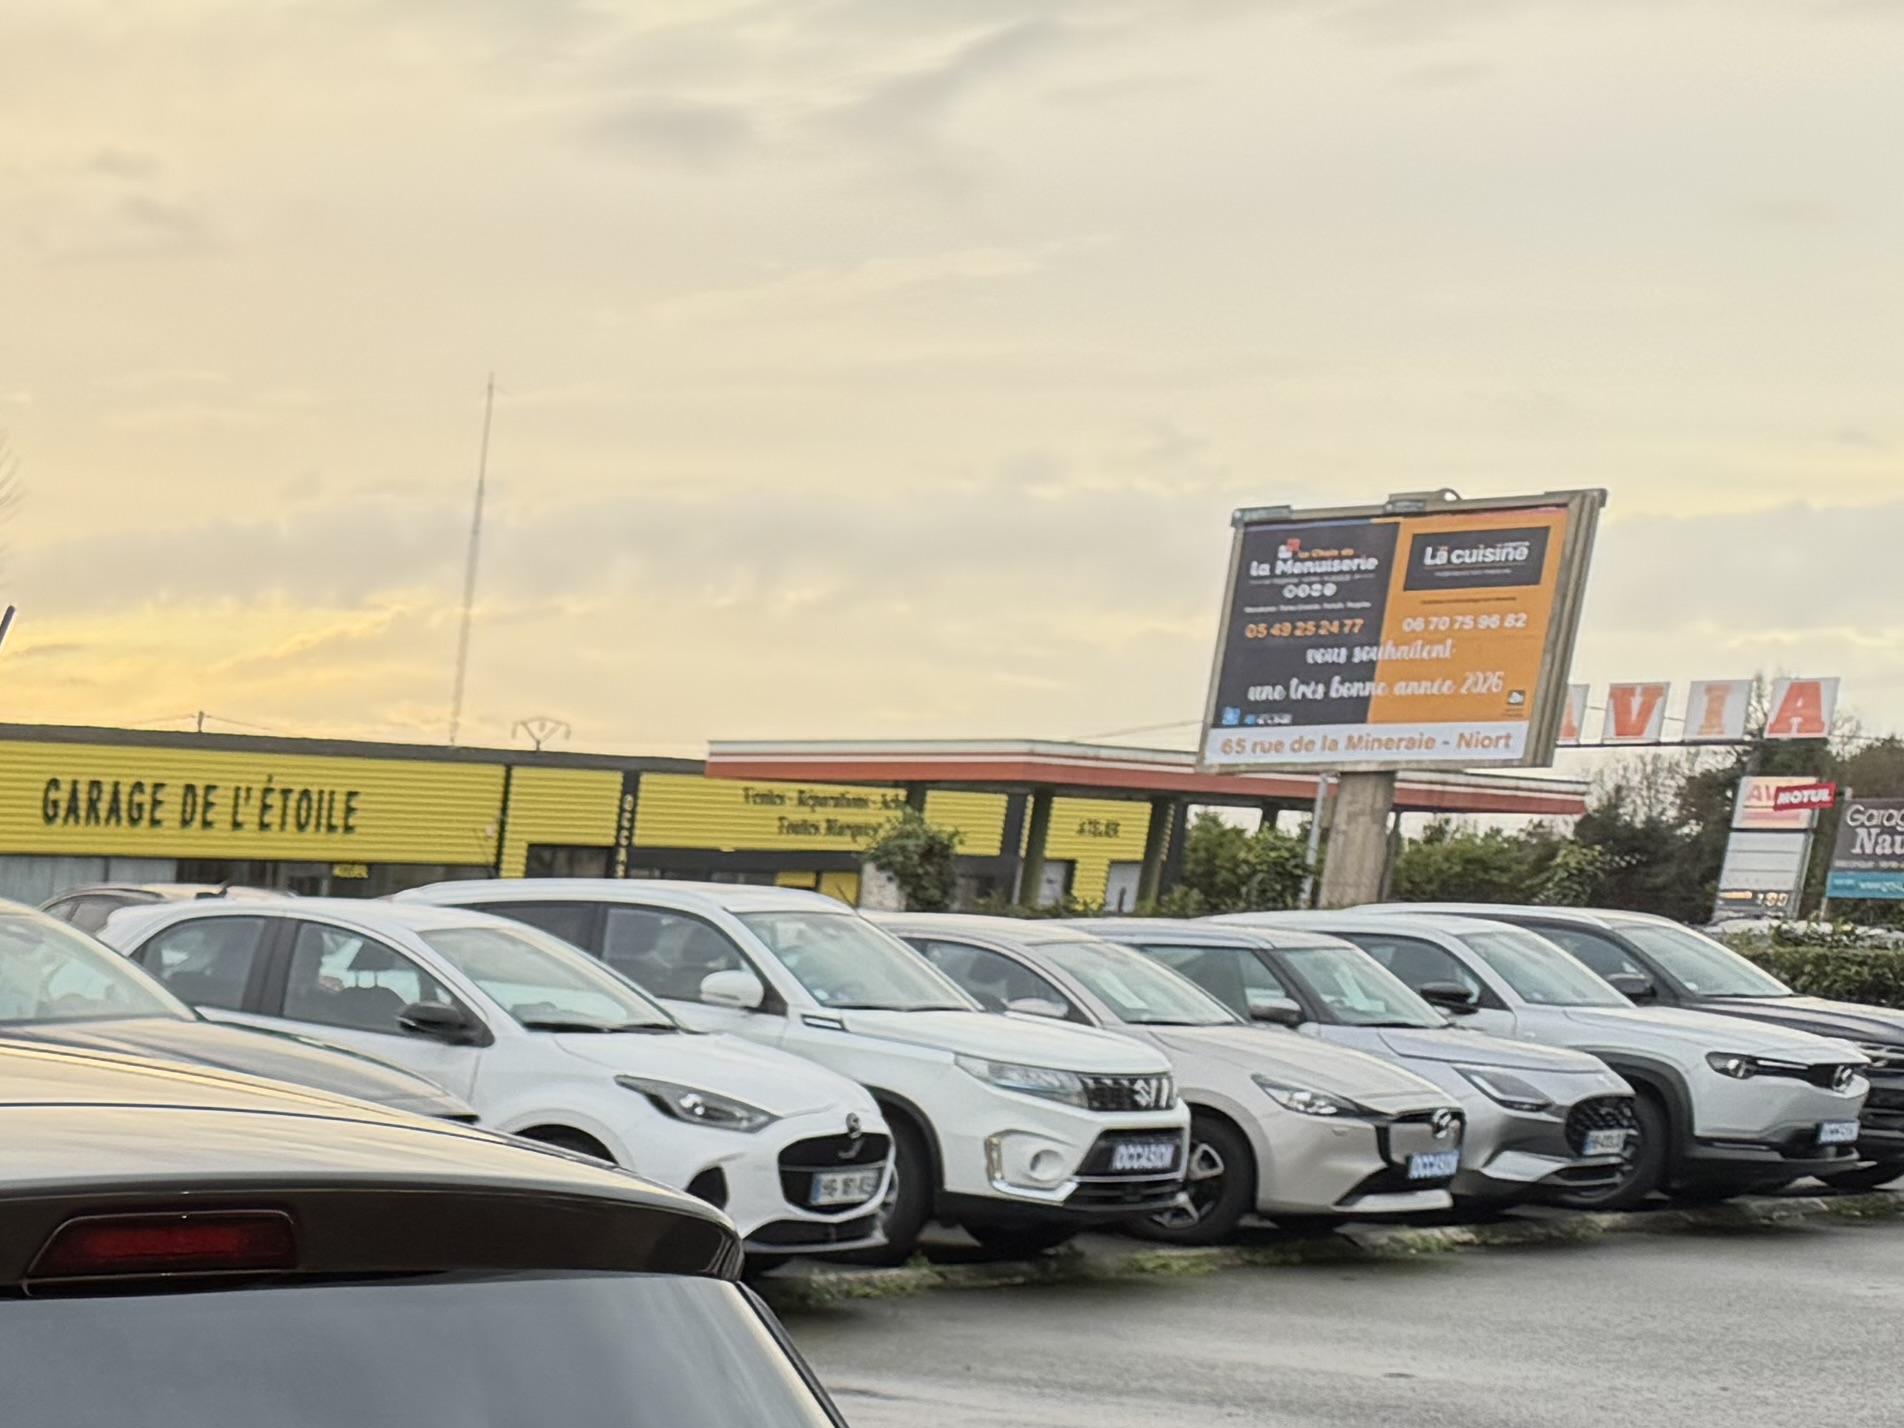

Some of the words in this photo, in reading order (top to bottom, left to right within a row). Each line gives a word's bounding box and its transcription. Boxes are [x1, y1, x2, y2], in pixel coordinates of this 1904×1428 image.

[1450, 542, 1530, 563] cuisine
[1275, 555, 1378, 575] Menuiserie
[1245, 623, 1268, 638] 05
[1343, 618, 1365, 634] 77
[1221, 738, 1247, 755] 65
[1251, 739, 1285, 754] rue
[1290, 736, 1316, 753] de
[1322, 735, 1339, 752] la
[1345, 732, 1436, 752] Mineraie
[1456, 731, 1513, 750] Niort
[43, 777, 168, 828] GARAGE
[180, 783, 218, 831] DE
[231, 773, 361, 834] L'ÉTOILE
[1778, 788, 1832, 804] MOTUL
